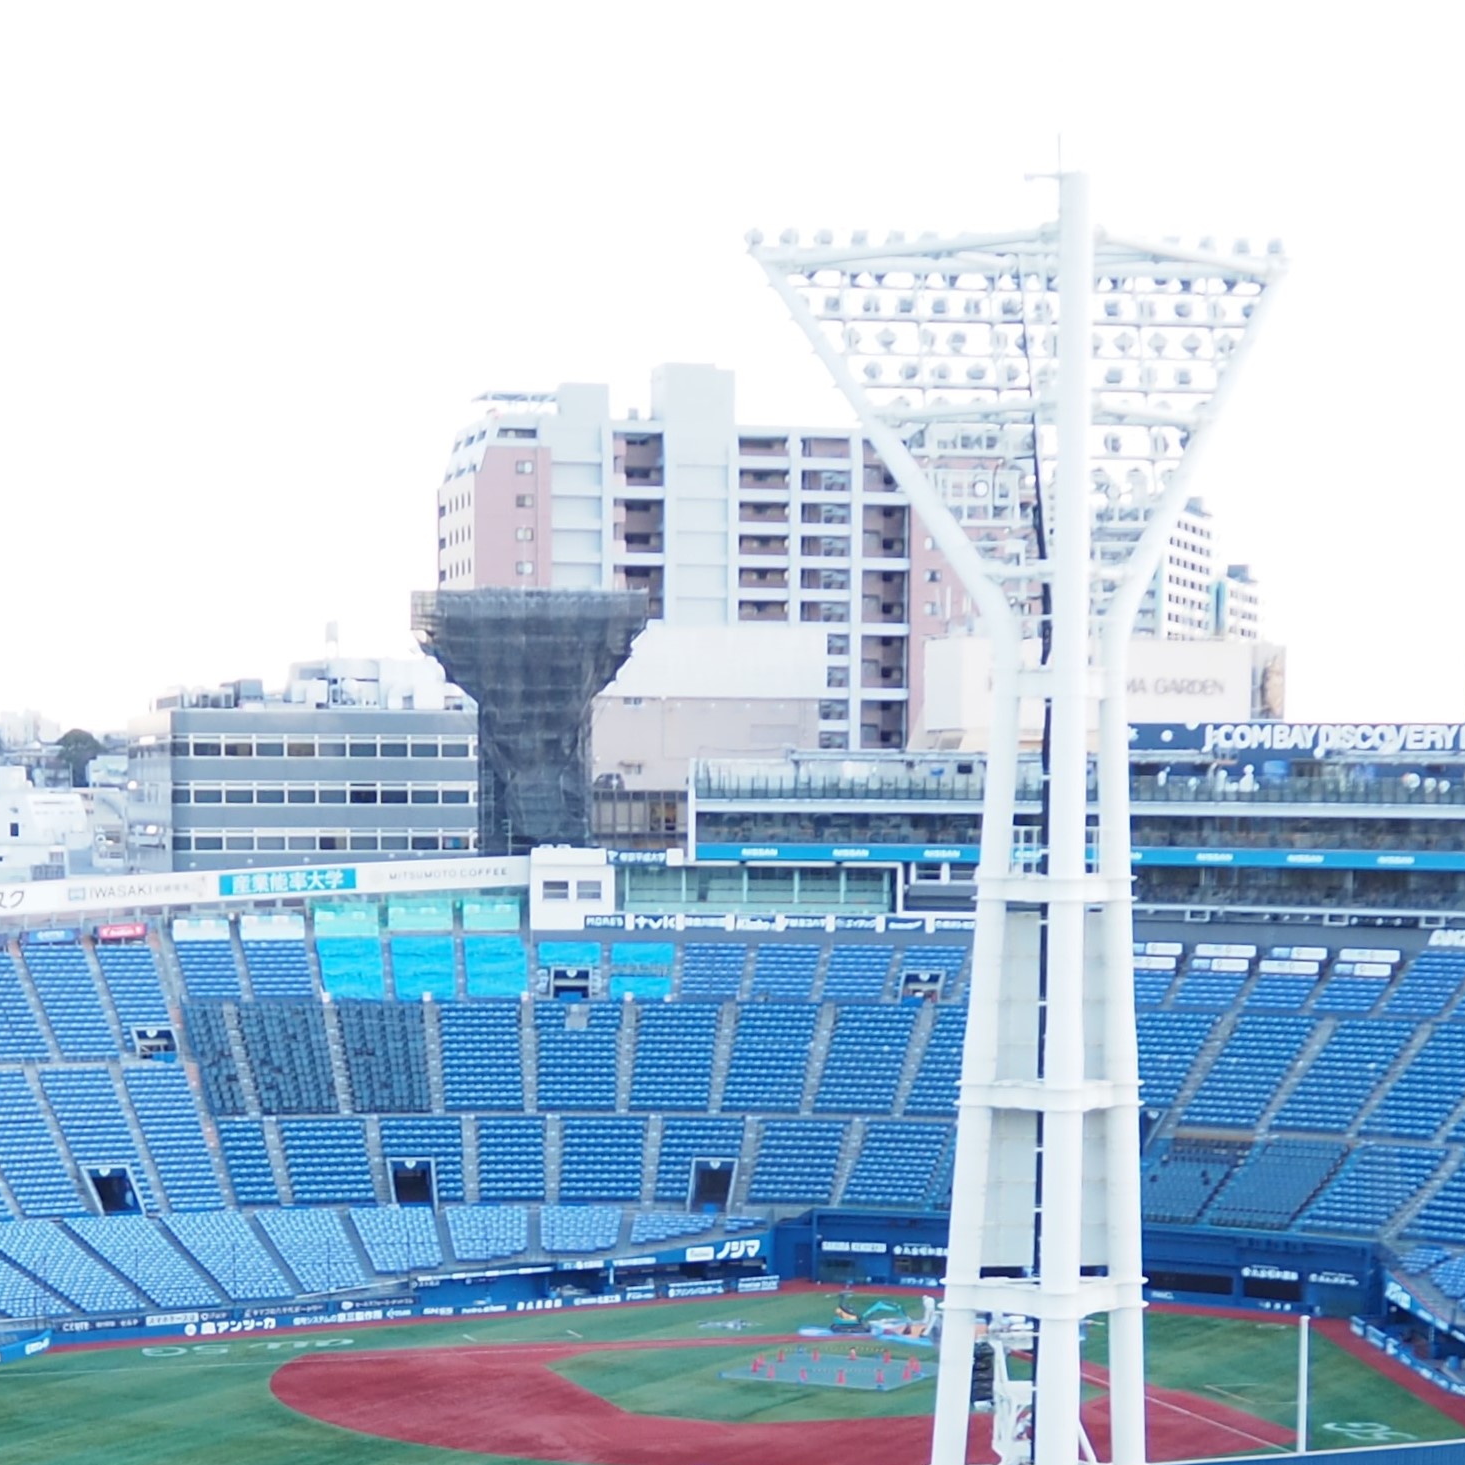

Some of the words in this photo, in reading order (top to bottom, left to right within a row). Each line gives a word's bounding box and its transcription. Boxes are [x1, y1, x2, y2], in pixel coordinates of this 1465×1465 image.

[1154, 677, 1226, 697] GARDEN
[1272, 724, 1317, 750] BAY
[1318, 724, 1456, 758] DISCOVERY
[232, 868, 345, 894] 産業能率大学
[388, 867, 458, 881] MITSUMOTO
[459, 865, 509, 878] COFFEE
[88, 884, 154, 901] IWASAKI
[716, 1239, 761, 1260] ノジマ
